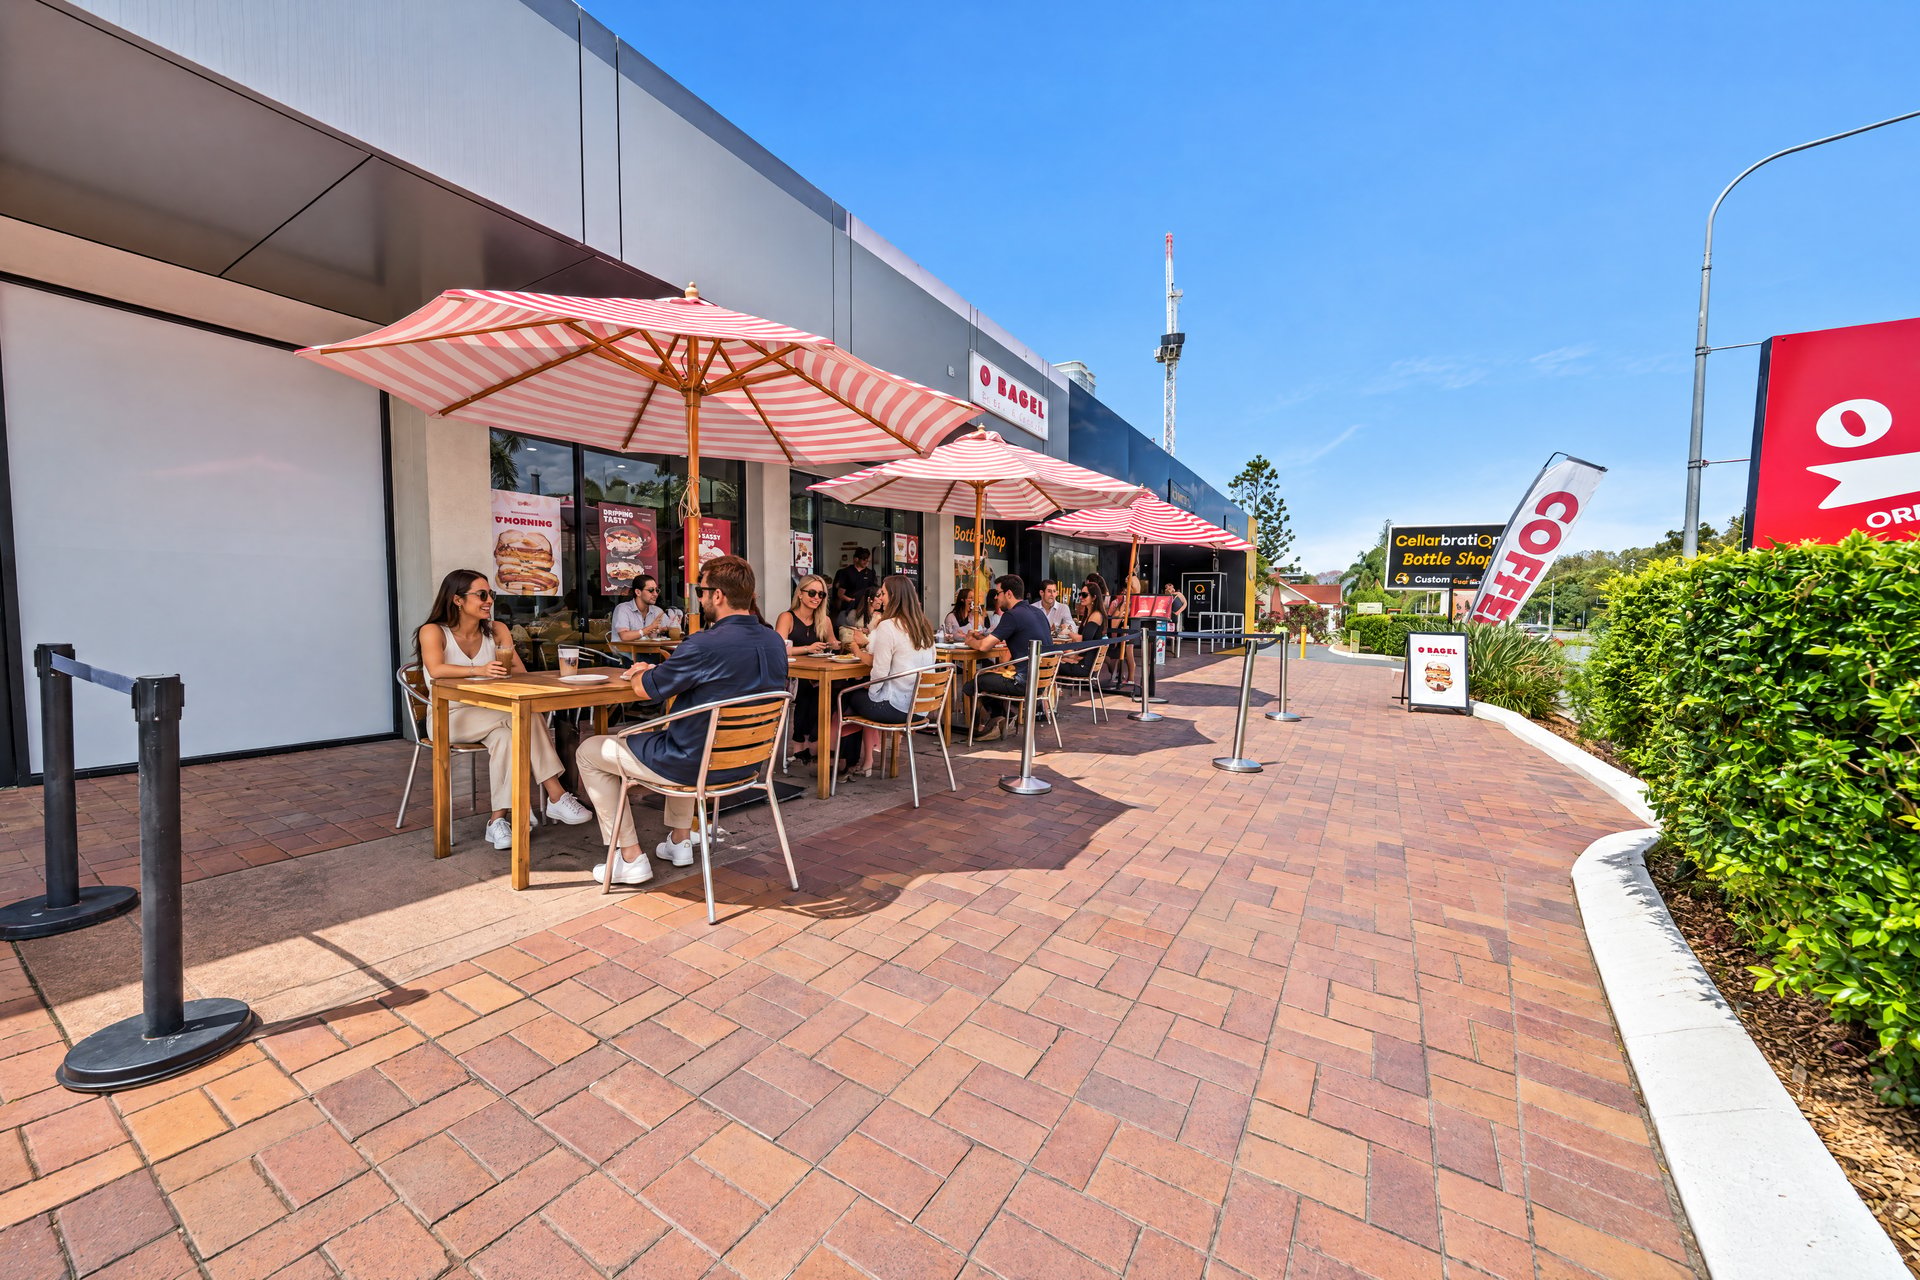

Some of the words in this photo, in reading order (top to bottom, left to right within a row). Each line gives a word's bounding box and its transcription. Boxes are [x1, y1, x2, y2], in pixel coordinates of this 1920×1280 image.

[980, 365, 991, 387] O
[998, 376, 1044, 419] BAGEL
[603, 509, 634, 518] DRIPPING
[603, 516, 627, 524] TASTY
[701, 533, 720, 541] SASSY
[985, 528, 1006, 553] Shop
[1402, 551, 1452, 566] Bottle
[1456, 552, 1493, 570] Shop
[1414, 576, 1450, 584] Custom
